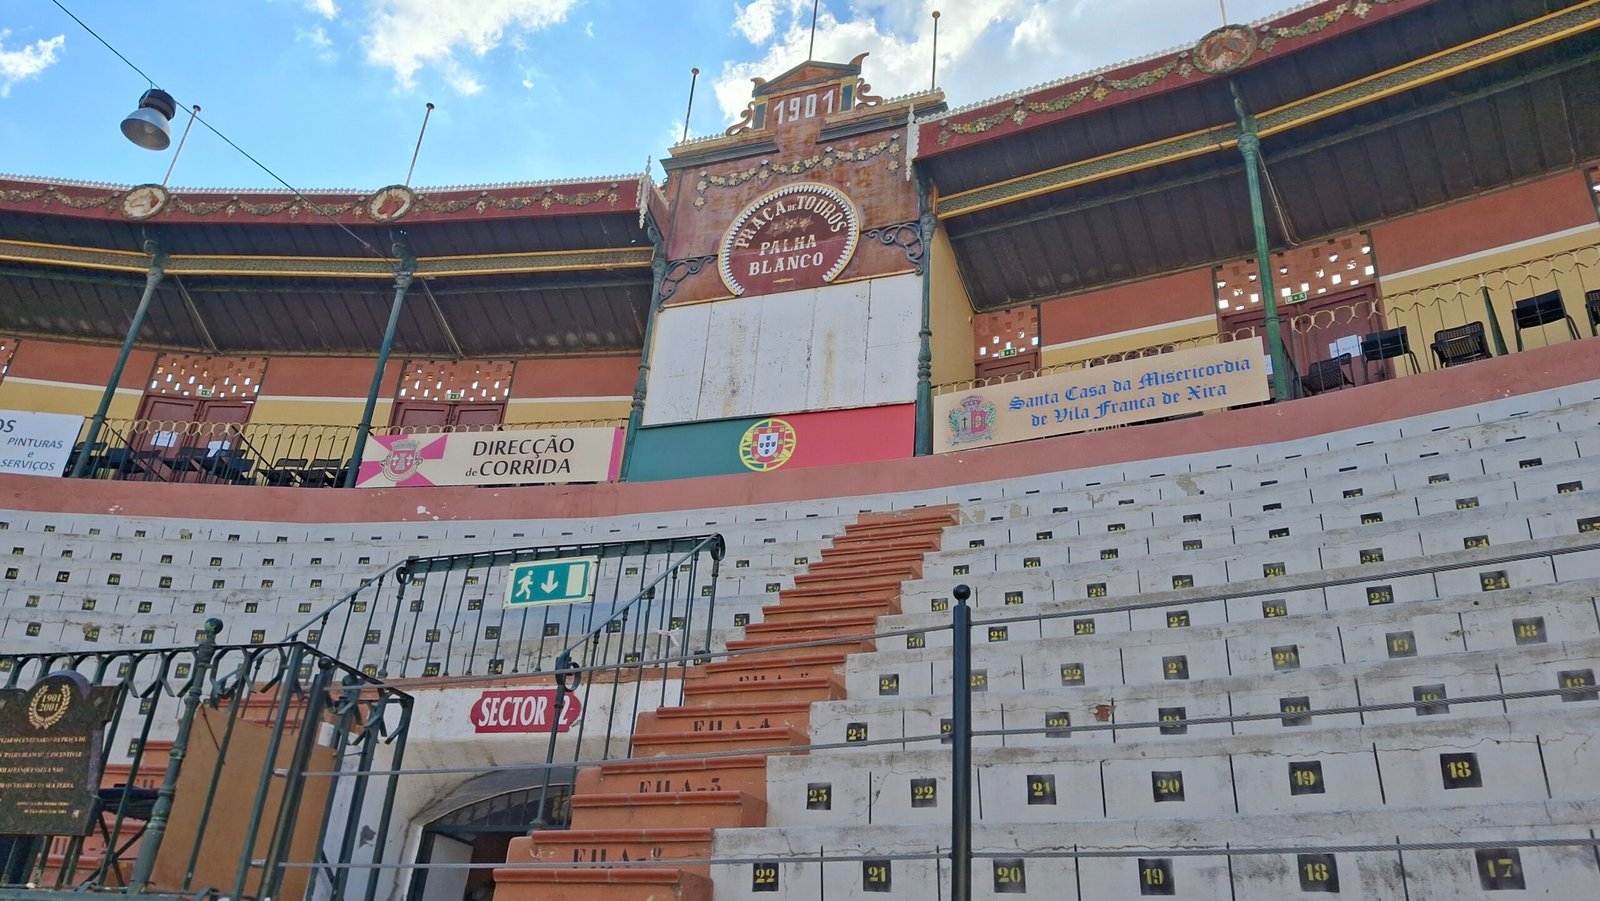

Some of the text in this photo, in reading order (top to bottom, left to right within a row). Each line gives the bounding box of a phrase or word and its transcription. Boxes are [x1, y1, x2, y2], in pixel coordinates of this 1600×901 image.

[773, 89, 834, 125] 1901
[734, 195, 847, 249] PRAÇA DE TOUROS
[759, 234, 817, 256] PALHA
[748, 252, 824, 276] BLANCO
[1009, 357, 1251, 411] Santa Casa da Misericordia
[1031, 384, 1227, 427] de Vila Franca de Xira
[7, 437, 64, 449] PINTURAS
[473, 434, 575, 458] DIRECÇÃO
[1, 459, 56, 471] SERVIÇOS
[465, 458, 571, 477] de CORRIDA
[1484, 576, 1507, 590] 24
[1370, 592, 1390, 604] 25
[1266, 606, 1284, 616] 26
[1076, 624, 1093, 634] 28
[1170, 616, 1186, 628] 27
[991, 630, 1006, 640] 29
[1519, 624, 1537, 638] 18
[1392, 639, 1409, 652] 19
[1275, 652, 1296, 665] 20
[1064, 669, 1081, 680] 22
[1168, 662, 1184, 674] 21
[881, 679, 897, 690] 24
[42, 693, 62, 703] 1901
[38, 703, 60, 712] 2001
[478, 695, 570, 727] SECTOR 2
[848, 728, 865, 740] 24
[1447, 761, 1472, 778] 18
[1294, 770, 1316, 786] 19
[914, 786, 933, 800] 22
[1032, 782, 1051, 796] 21
[1157, 779, 1180, 793] 20
[808, 790, 826, 802] 23
[868, 866, 886, 882] 21
[997, 866, 1022, 883] 20
[1304, 863, 1329, 881] 18
[1488, 858, 1513, 878] 17
[754, 868, 776, 884] 22
[1143, 868, 1164, 885] 19
